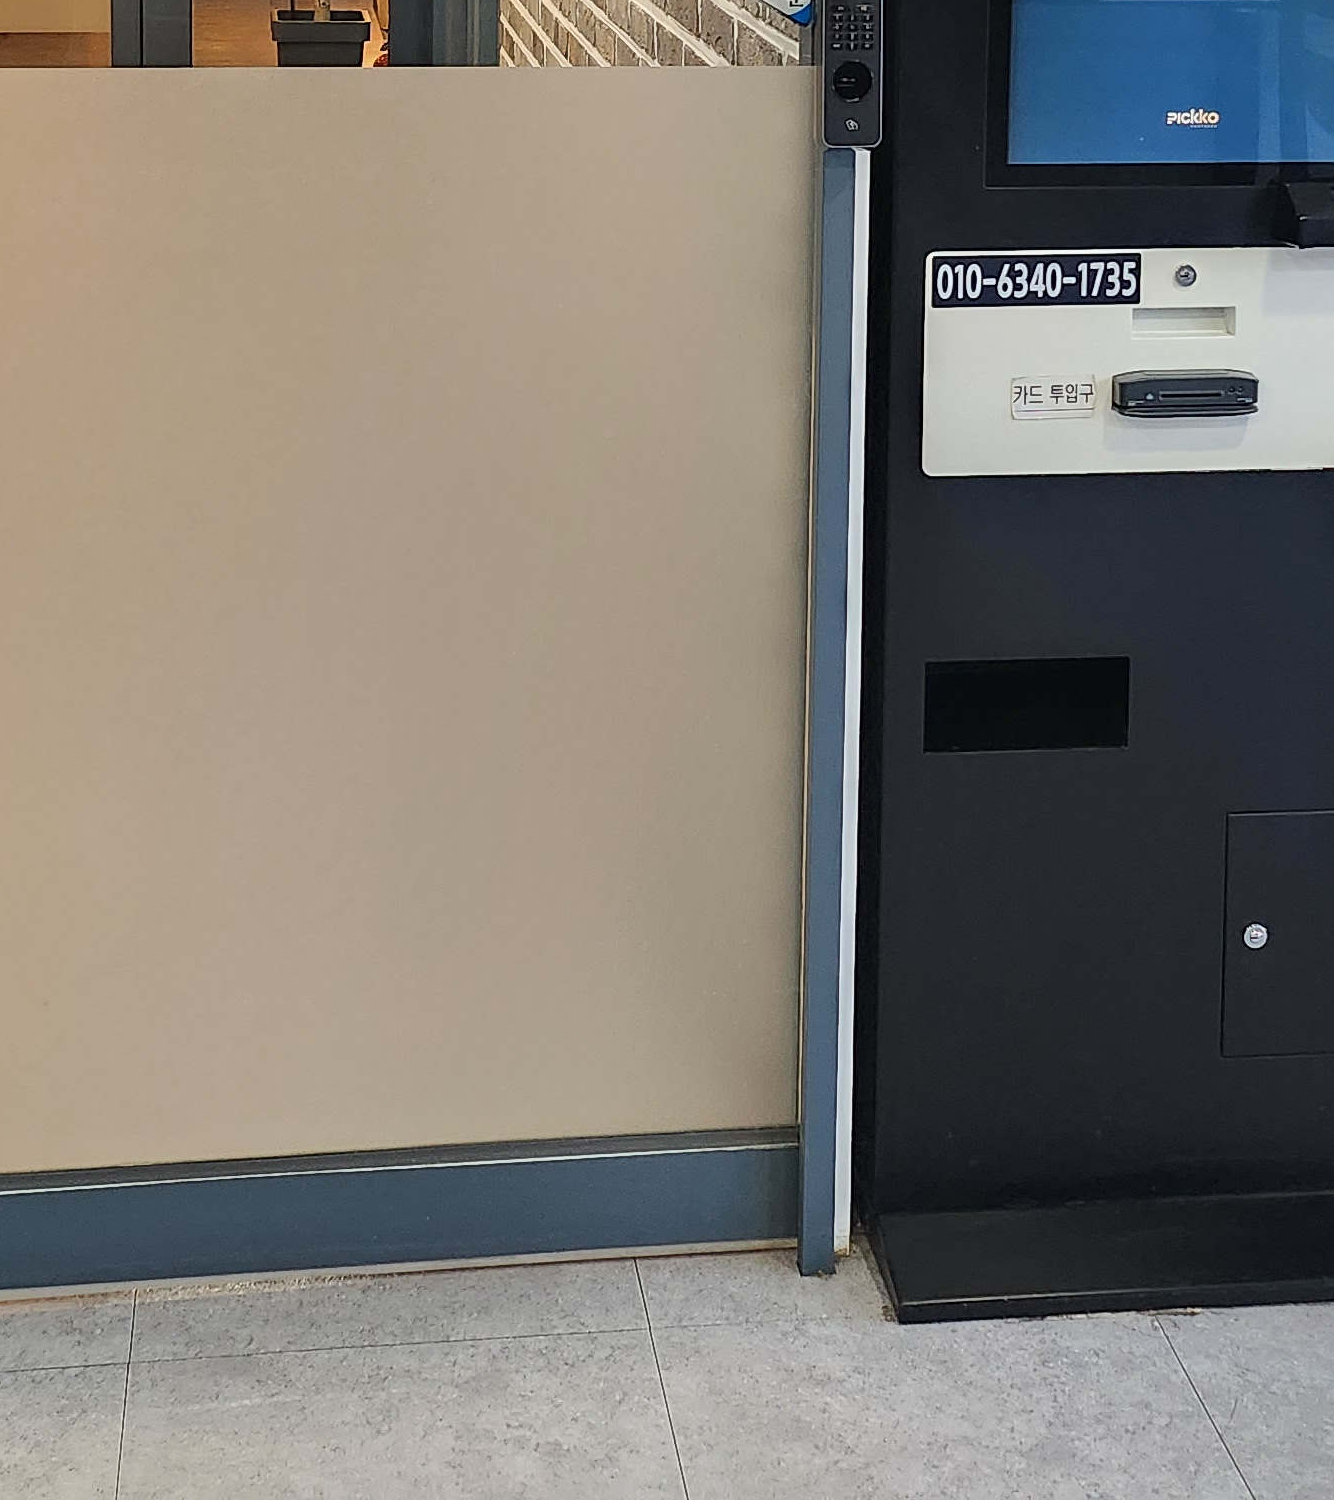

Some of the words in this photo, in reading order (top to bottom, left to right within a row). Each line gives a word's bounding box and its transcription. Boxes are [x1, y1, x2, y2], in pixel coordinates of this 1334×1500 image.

[936, 261, 1137, 300] 010-6340-1735
[1012, 384, 1043, 405] 카드
[1049, 383, 1094, 404] 투입구
